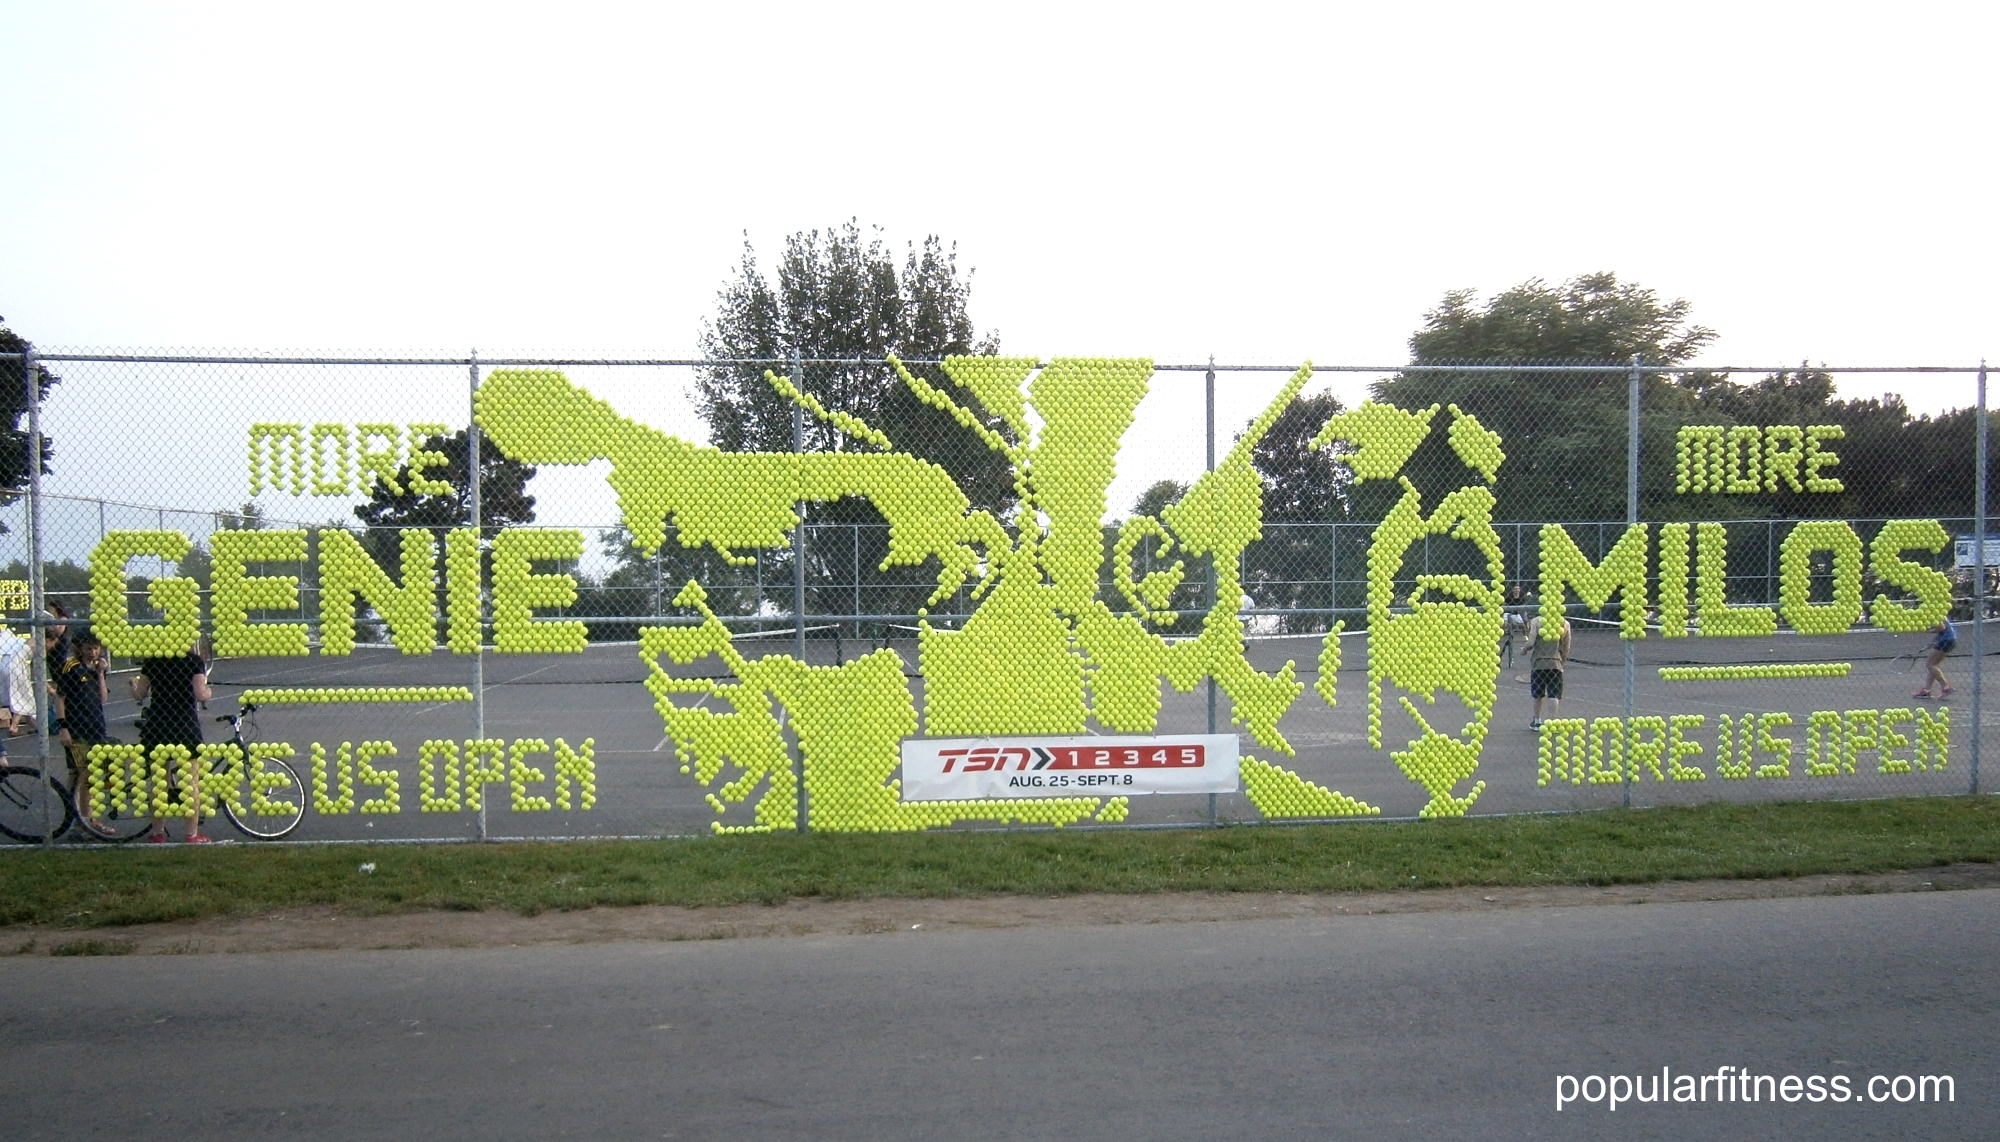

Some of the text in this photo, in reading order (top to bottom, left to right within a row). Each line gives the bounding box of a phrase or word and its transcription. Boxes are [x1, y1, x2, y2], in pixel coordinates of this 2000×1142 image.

[248, 422, 453, 497] MORE
[1676, 425, 1845, 494] MORE
[88, 529, 588, 658] GENIE
[1538, 520, 1952, 641] MILOS
[87, 737, 596, 818] MORE US OPEN
[937, 747, 1196, 773] TSN 1 2 3 4 5
[1008, 775, 1046, 788] AUG.
[1123, 774, 1133, 785] 8
[1536, 707, 1949, 787] MORE US OPEN
